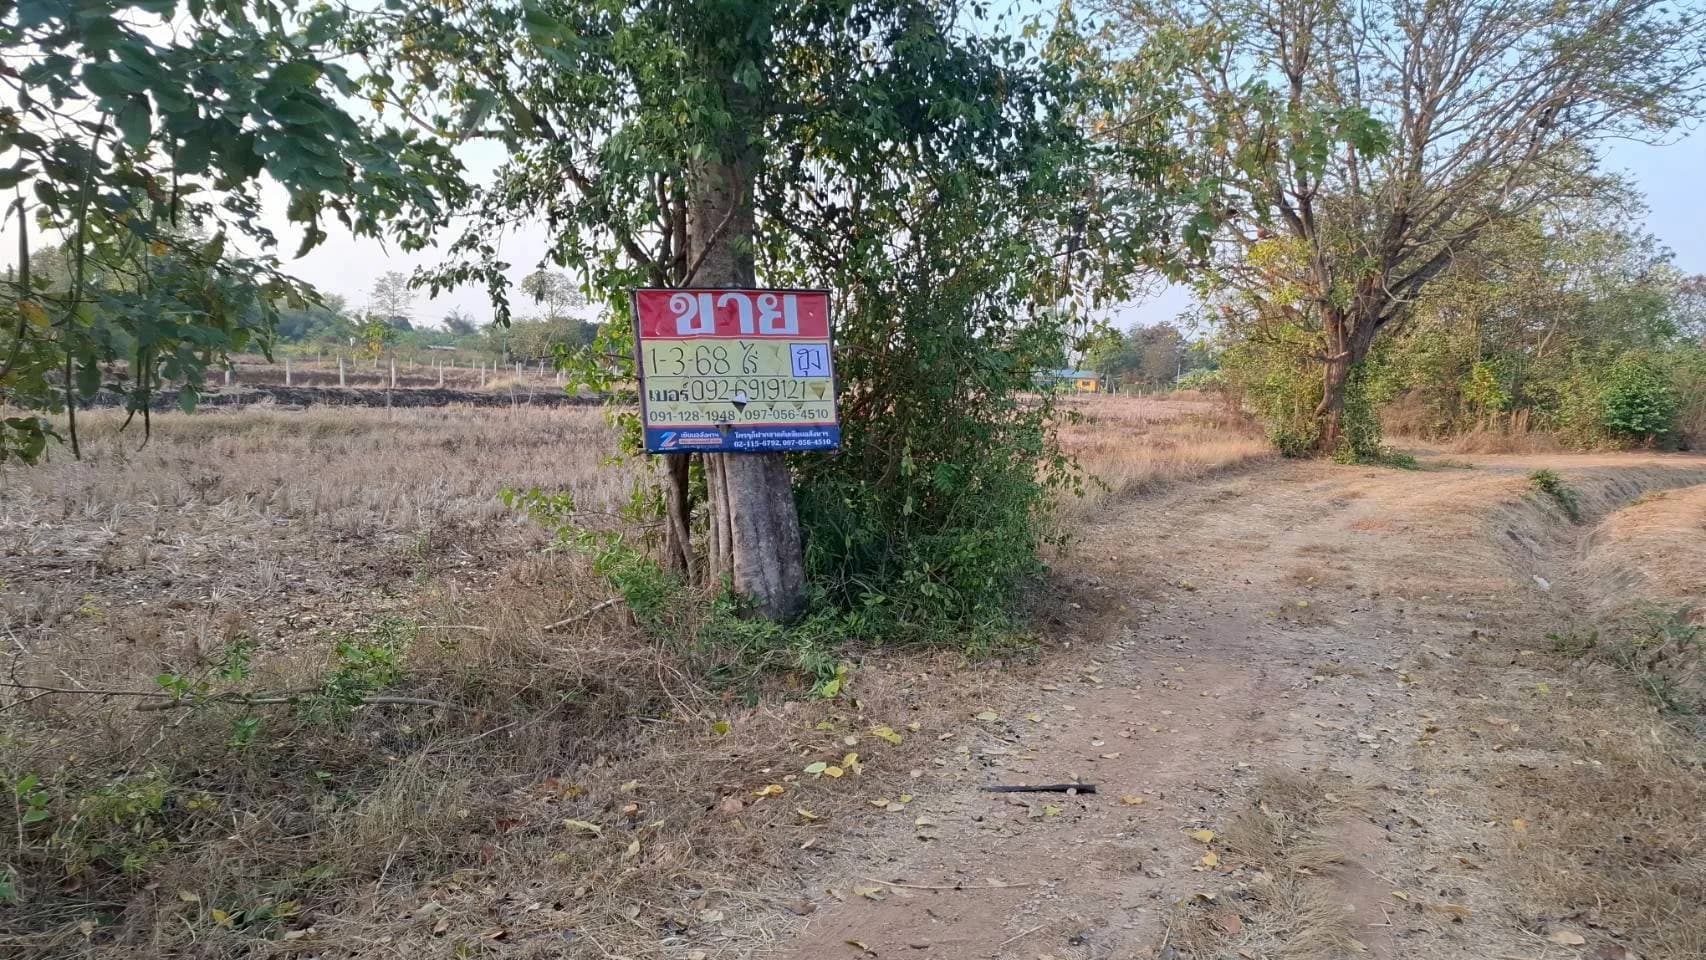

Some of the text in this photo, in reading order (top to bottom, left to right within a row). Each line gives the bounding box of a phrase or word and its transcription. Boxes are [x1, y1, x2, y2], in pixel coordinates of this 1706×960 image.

[669, 292, 799, 335] ขาย
[651, 340, 759, 375] 1-3-68 ไร่
[648, 378, 805, 401] เบอร์ 092-6919121
[744, 408, 829, 420] 097-056-4510
